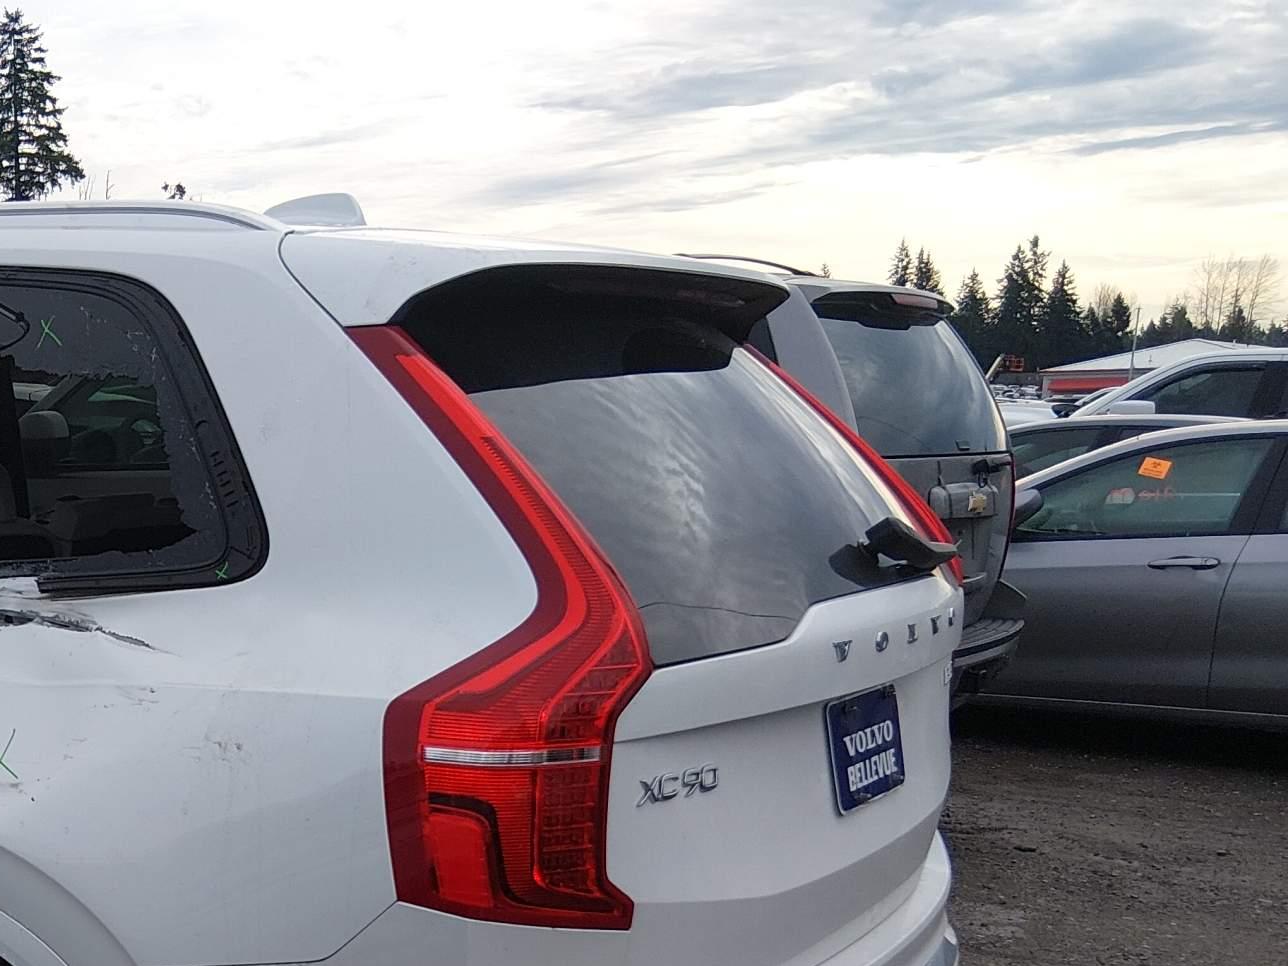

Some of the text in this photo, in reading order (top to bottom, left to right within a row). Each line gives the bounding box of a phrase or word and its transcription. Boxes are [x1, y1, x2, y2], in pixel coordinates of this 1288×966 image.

[843, 720, 893, 757] VOLVO
[636, 763, 719, 808] XC90
[847, 748, 898, 792] BELLEVUE
